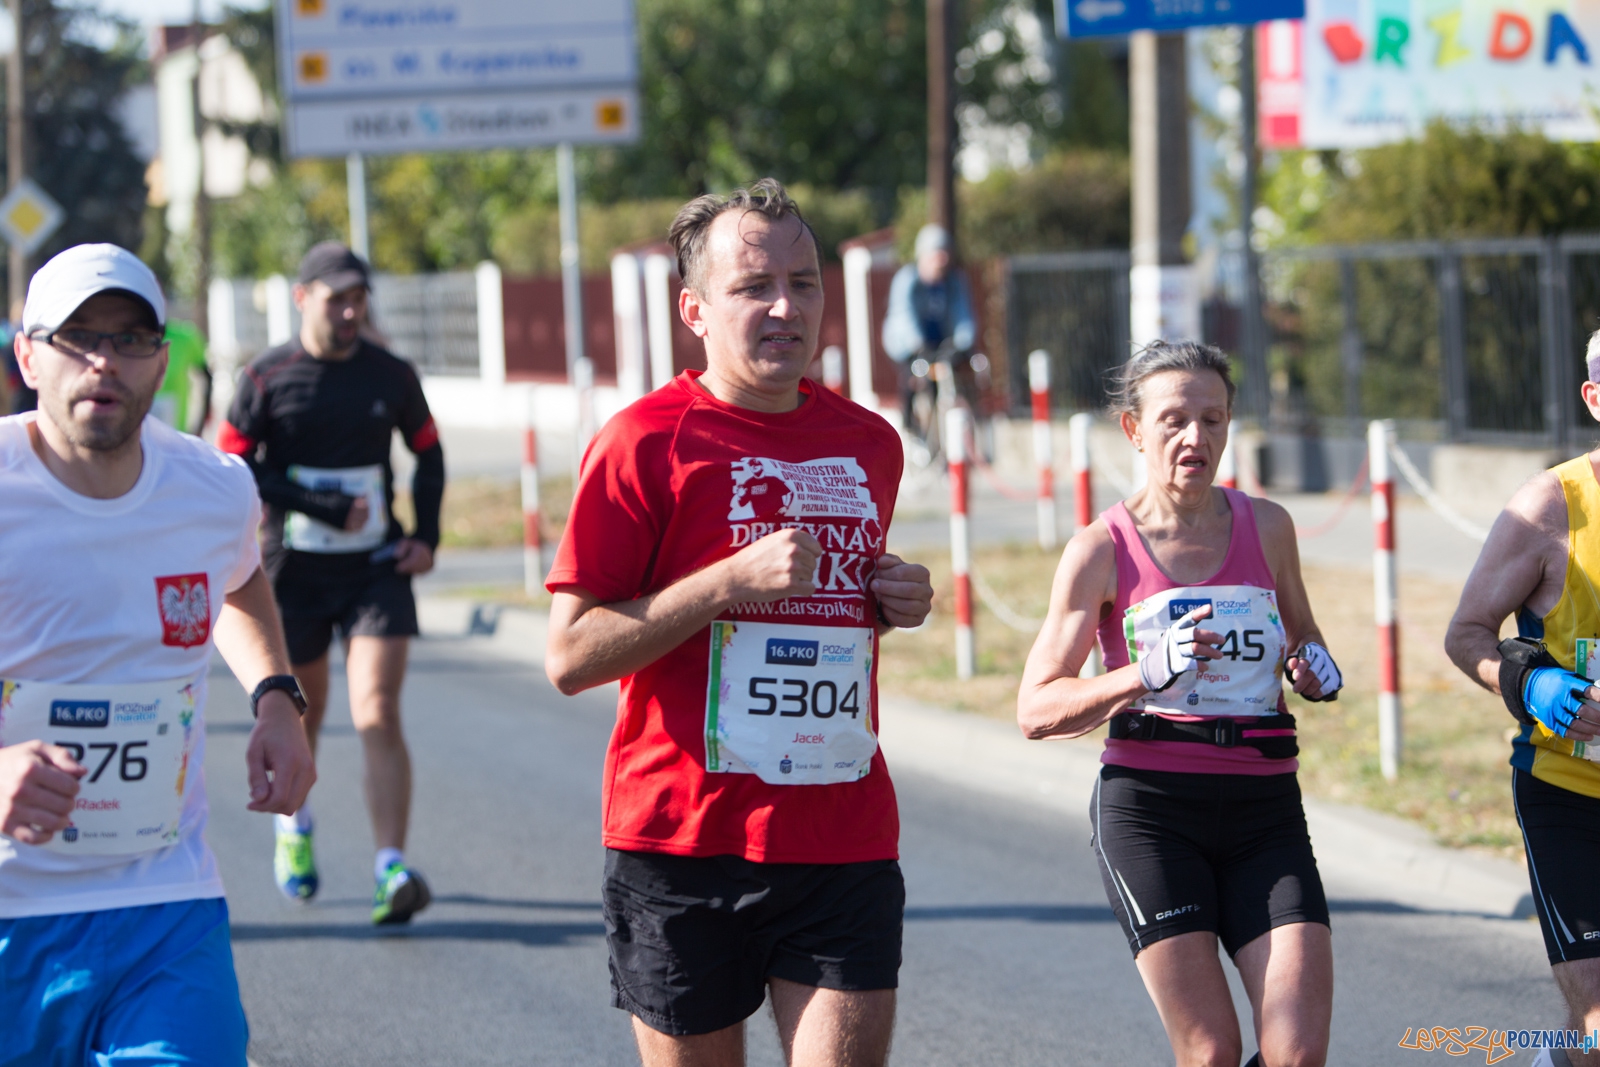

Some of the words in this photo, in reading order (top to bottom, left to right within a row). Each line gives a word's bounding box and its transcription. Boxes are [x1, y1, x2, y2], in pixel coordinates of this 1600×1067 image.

[777, 461, 848, 476] MISTRZOSTWA
[822, 476, 857, 488] SZPIKU
[794, 482, 804, 492] W
[805, 483, 859, 500] MARATONIE
[1172, 605, 1187, 614] 16.
[1217, 607, 1252, 615] maraton
[770, 645, 788, 657] 16.
[789, 646, 815, 659] PKO
[821, 655, 854, 663] maraton
[1196, 671, 1230, 683] Regina
[748, 677, 860, 719] 5304
[55, 707, 74, 721] 16.
[75, 708, 107, 721] PKO
[113, 712, 157, 723] maraton
[792, 733, 825, 744] Jacek
[76, 798, 120, 811] Radek
[1155, 904, 1193, 921] CRAFT
